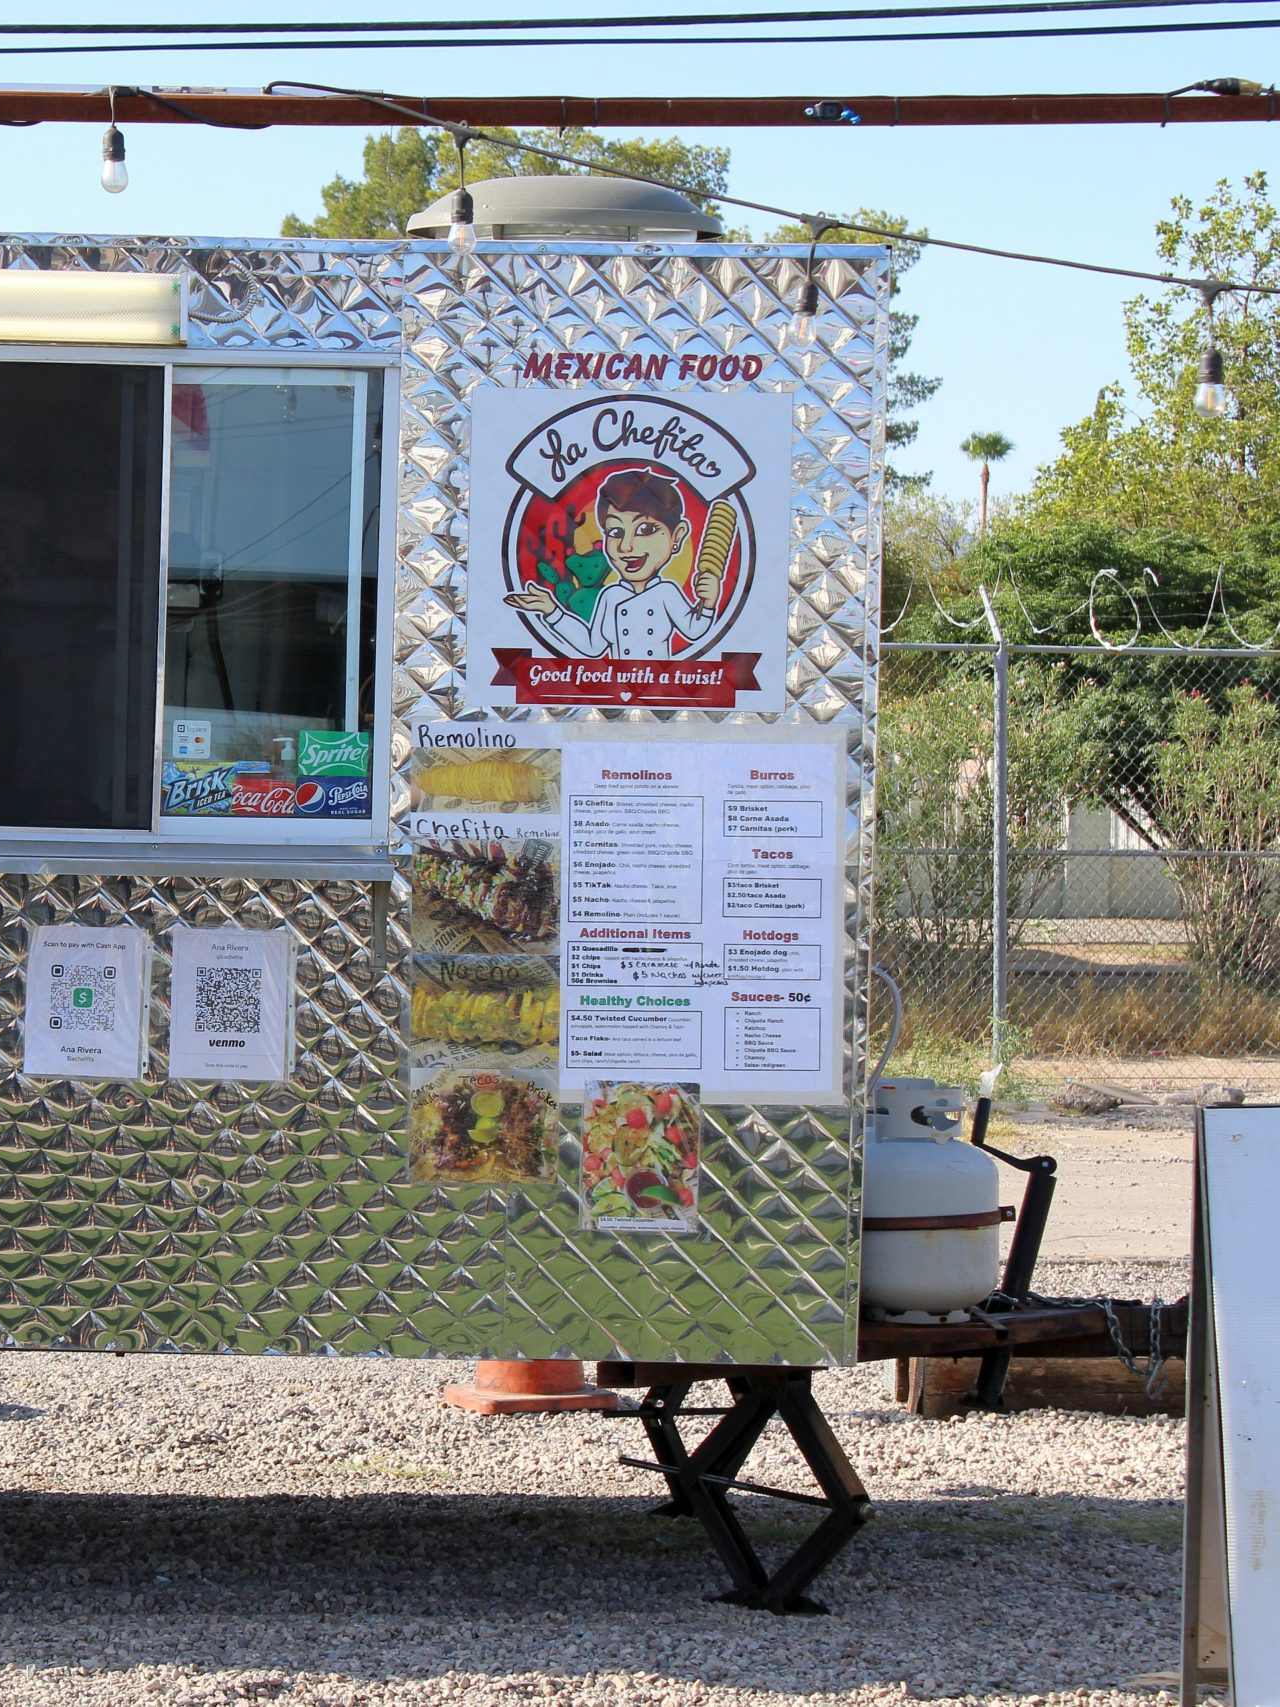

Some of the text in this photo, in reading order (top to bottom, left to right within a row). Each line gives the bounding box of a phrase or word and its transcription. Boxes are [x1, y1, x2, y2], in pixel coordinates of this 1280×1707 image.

[523, 352, 763, 381] MEXICAN FOOD
[539, 408, 721, 482] La Chefita
[529, 664, 723, 686] Good food with a twist!
[418, 725, 516, 748] Remolino
[302, 743, 361, 767] Sprite
[602, 770, 672, 780] Remolinos
[750, 770, 795, 780] Burros
[214, 791, 225, 801] TEA
[416, 818, 509, 840] Chefita
[752, 849, 793, 859] Tacos
[580, 928, 691, 939] Additional Items
[743, 930, 799, 942] Hotdogs
[580, 996, 690, 1008] Healthy Choices
[789, 993, 811, 1003] 50¢
